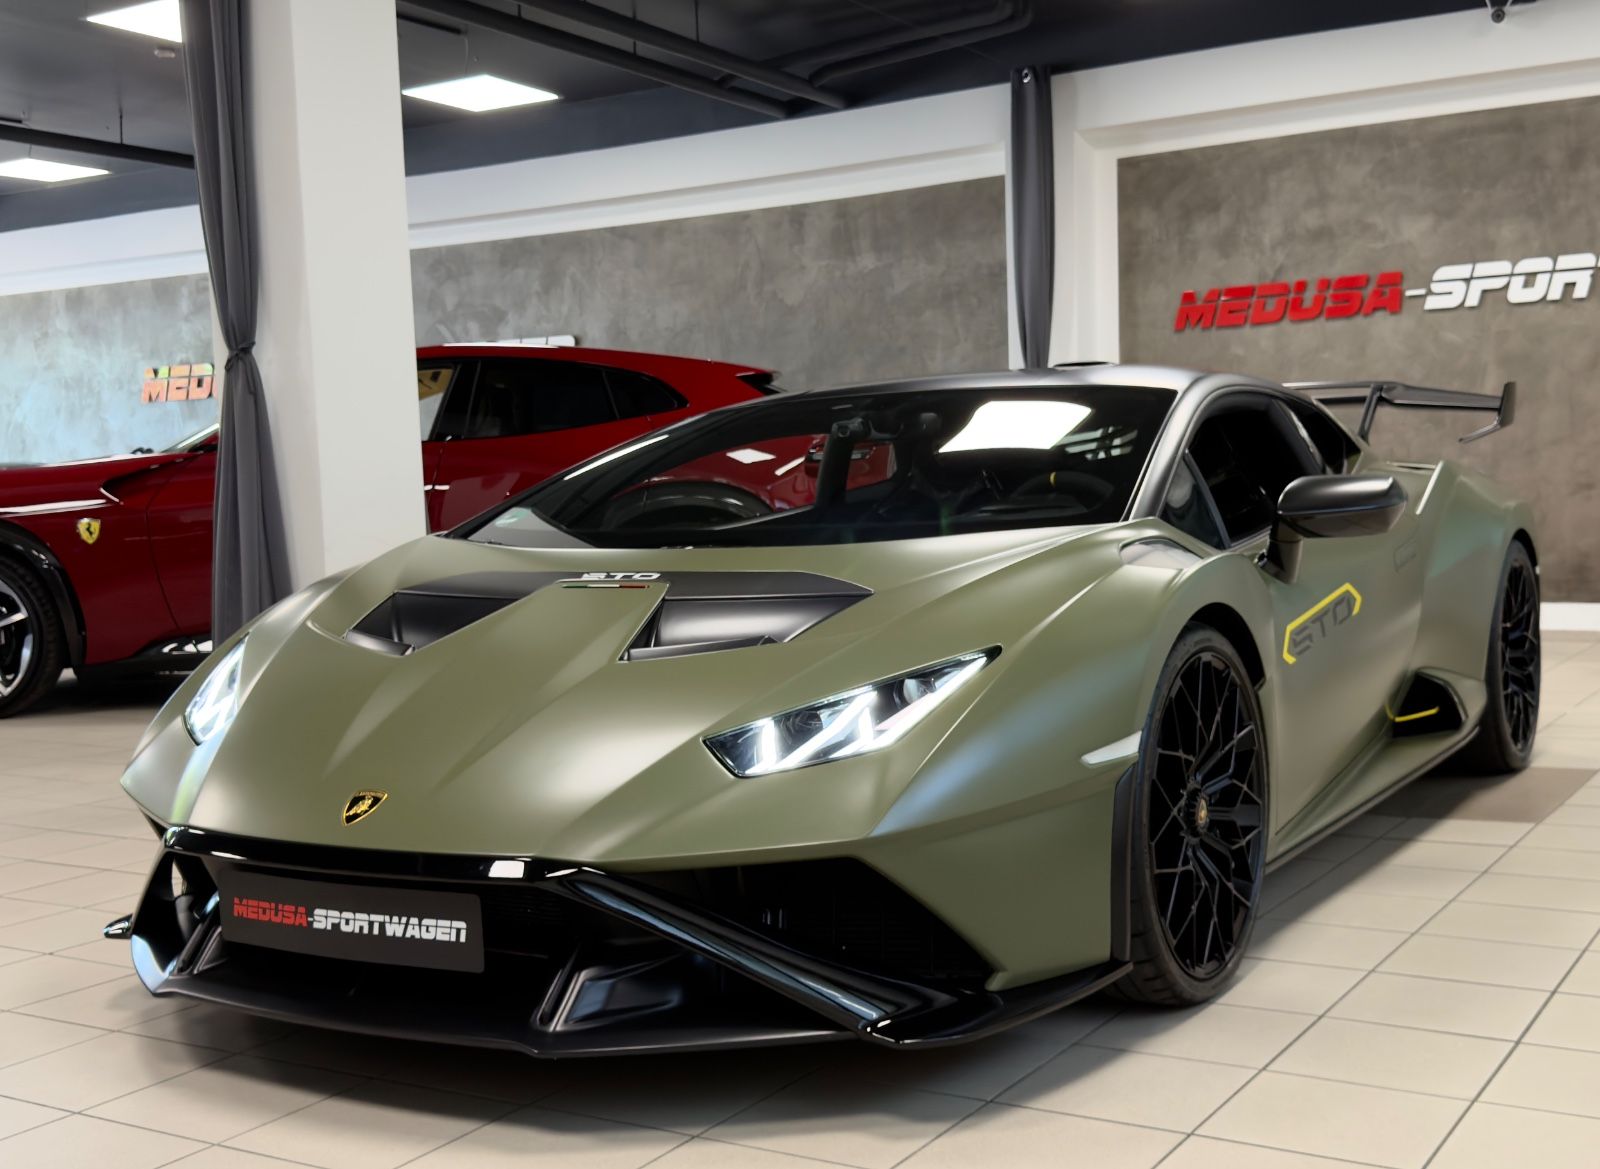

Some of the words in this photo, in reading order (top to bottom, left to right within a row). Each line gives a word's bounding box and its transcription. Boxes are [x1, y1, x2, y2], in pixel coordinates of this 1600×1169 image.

[1174, 252, 1600, 332] MEDUSA-SPOR
[142, 362, 218, 404] MED
[581, 572, 662, 580] STO
[1293, 596, 1353, 656] STO
[233, 897, 467, 943] MEDUSA-SPORTWAGEN
